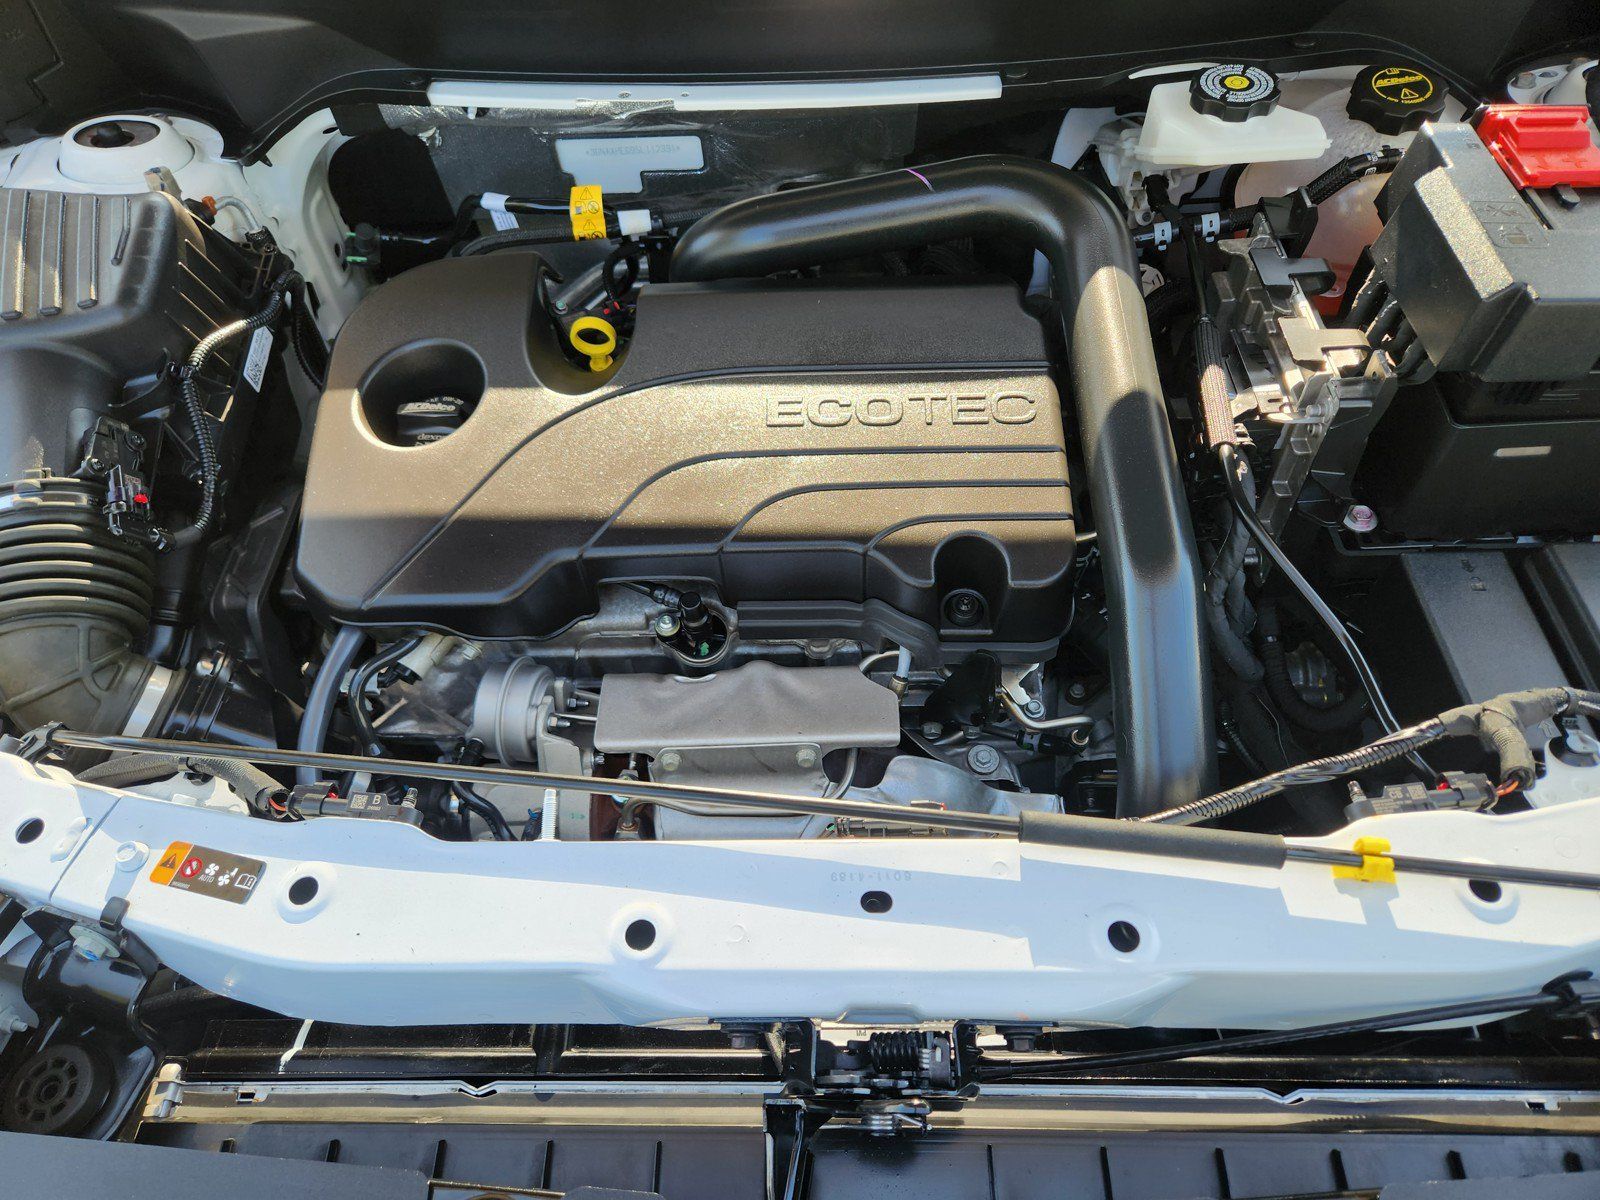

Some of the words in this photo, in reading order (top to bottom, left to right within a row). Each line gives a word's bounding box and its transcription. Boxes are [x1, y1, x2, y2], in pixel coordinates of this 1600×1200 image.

[1375, 75, 1423, 87] ACDelco
[403, 402, 456, 412] ACDelco
[766, 391, 1037, 427] ECOTEC
[372, 794, 382, 804] B
[198, 873, 215, 883] AUTO
